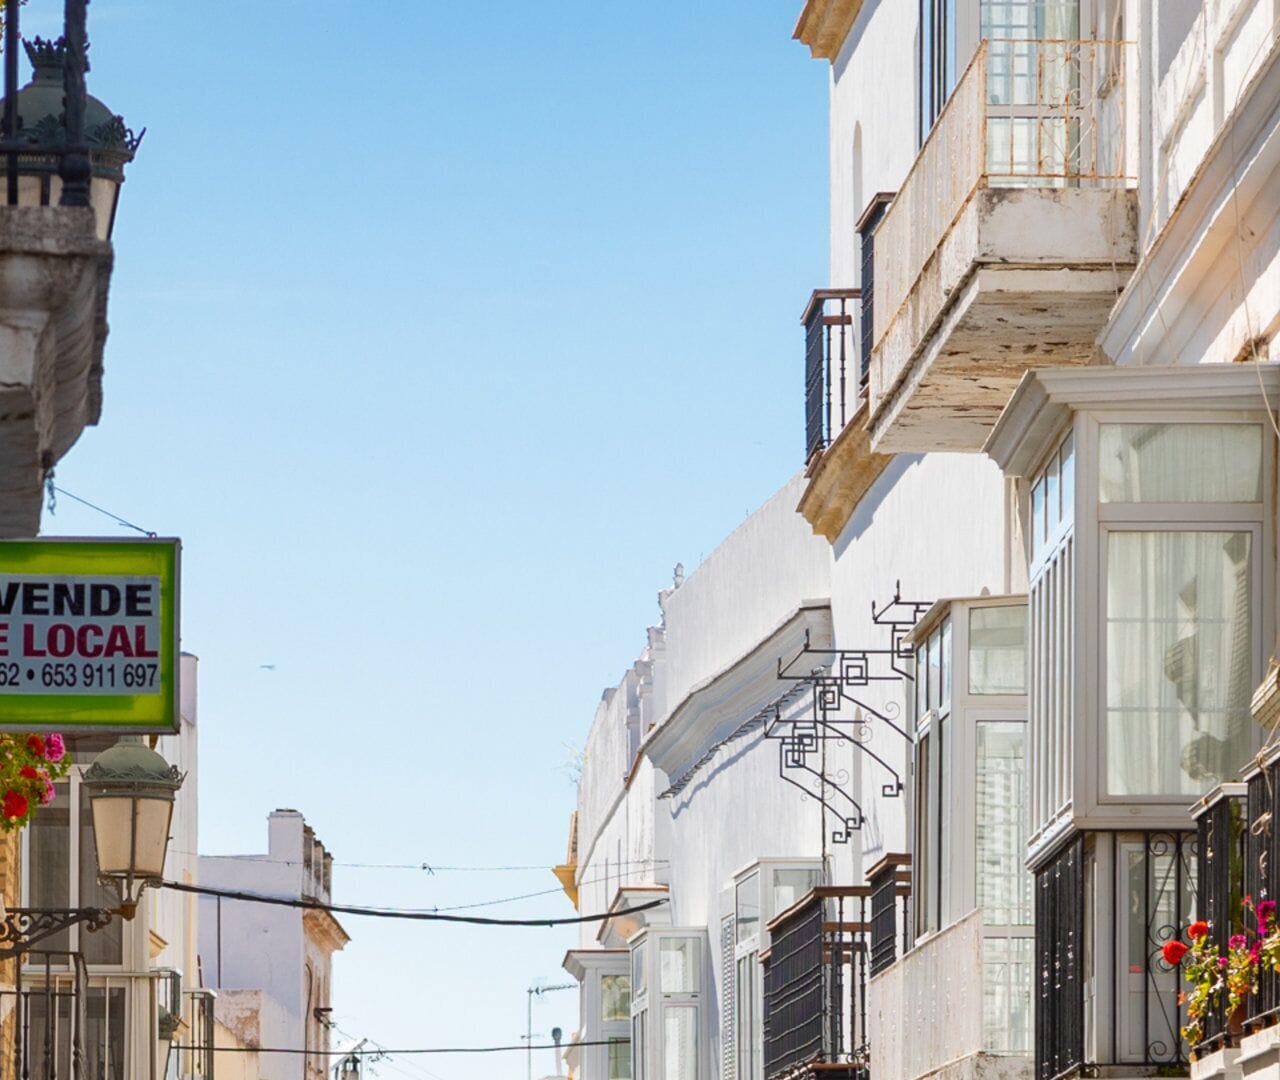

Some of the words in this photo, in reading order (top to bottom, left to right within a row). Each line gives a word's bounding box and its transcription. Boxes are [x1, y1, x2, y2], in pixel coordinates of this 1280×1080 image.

[23, 623, 159, 658] LOCAL
[41, 663, 77, 687] 653
[83, 664, 115, 687] 911
[123, 664, 158, 688] 697
